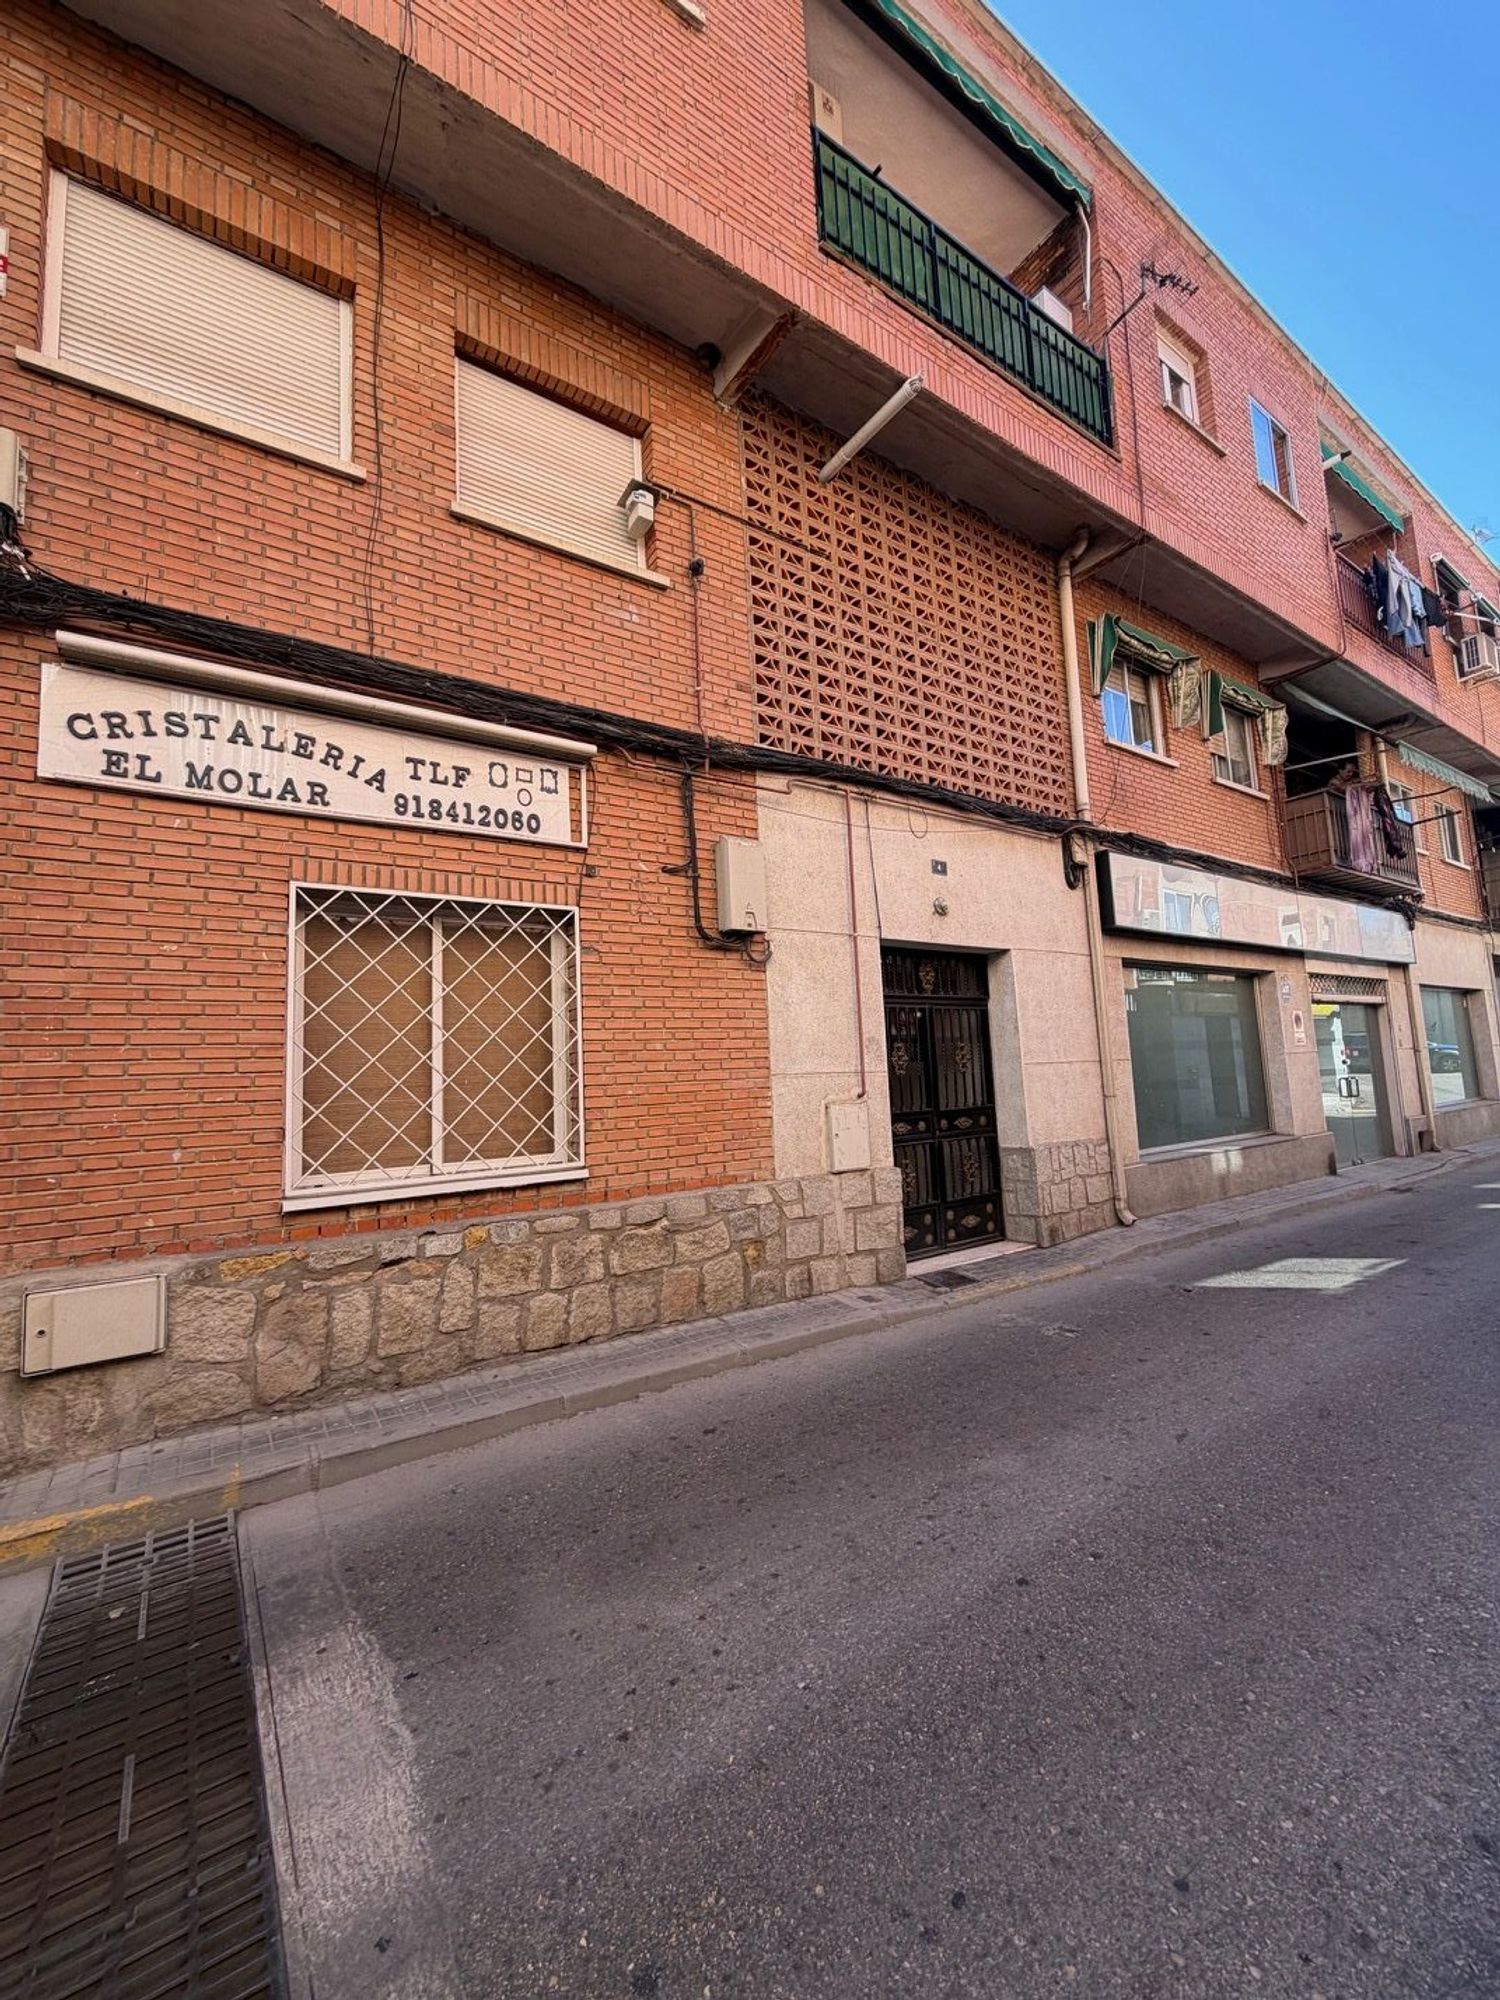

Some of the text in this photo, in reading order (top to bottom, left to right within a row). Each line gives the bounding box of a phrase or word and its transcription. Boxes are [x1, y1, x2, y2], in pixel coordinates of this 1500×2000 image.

[67, 710, 386, 792] CRISTALERIA
[405, 757, 471, 788] TLF
[101, 749, 331, 806] EL MOLAR
[394, 793, 541, 834] 918412060
